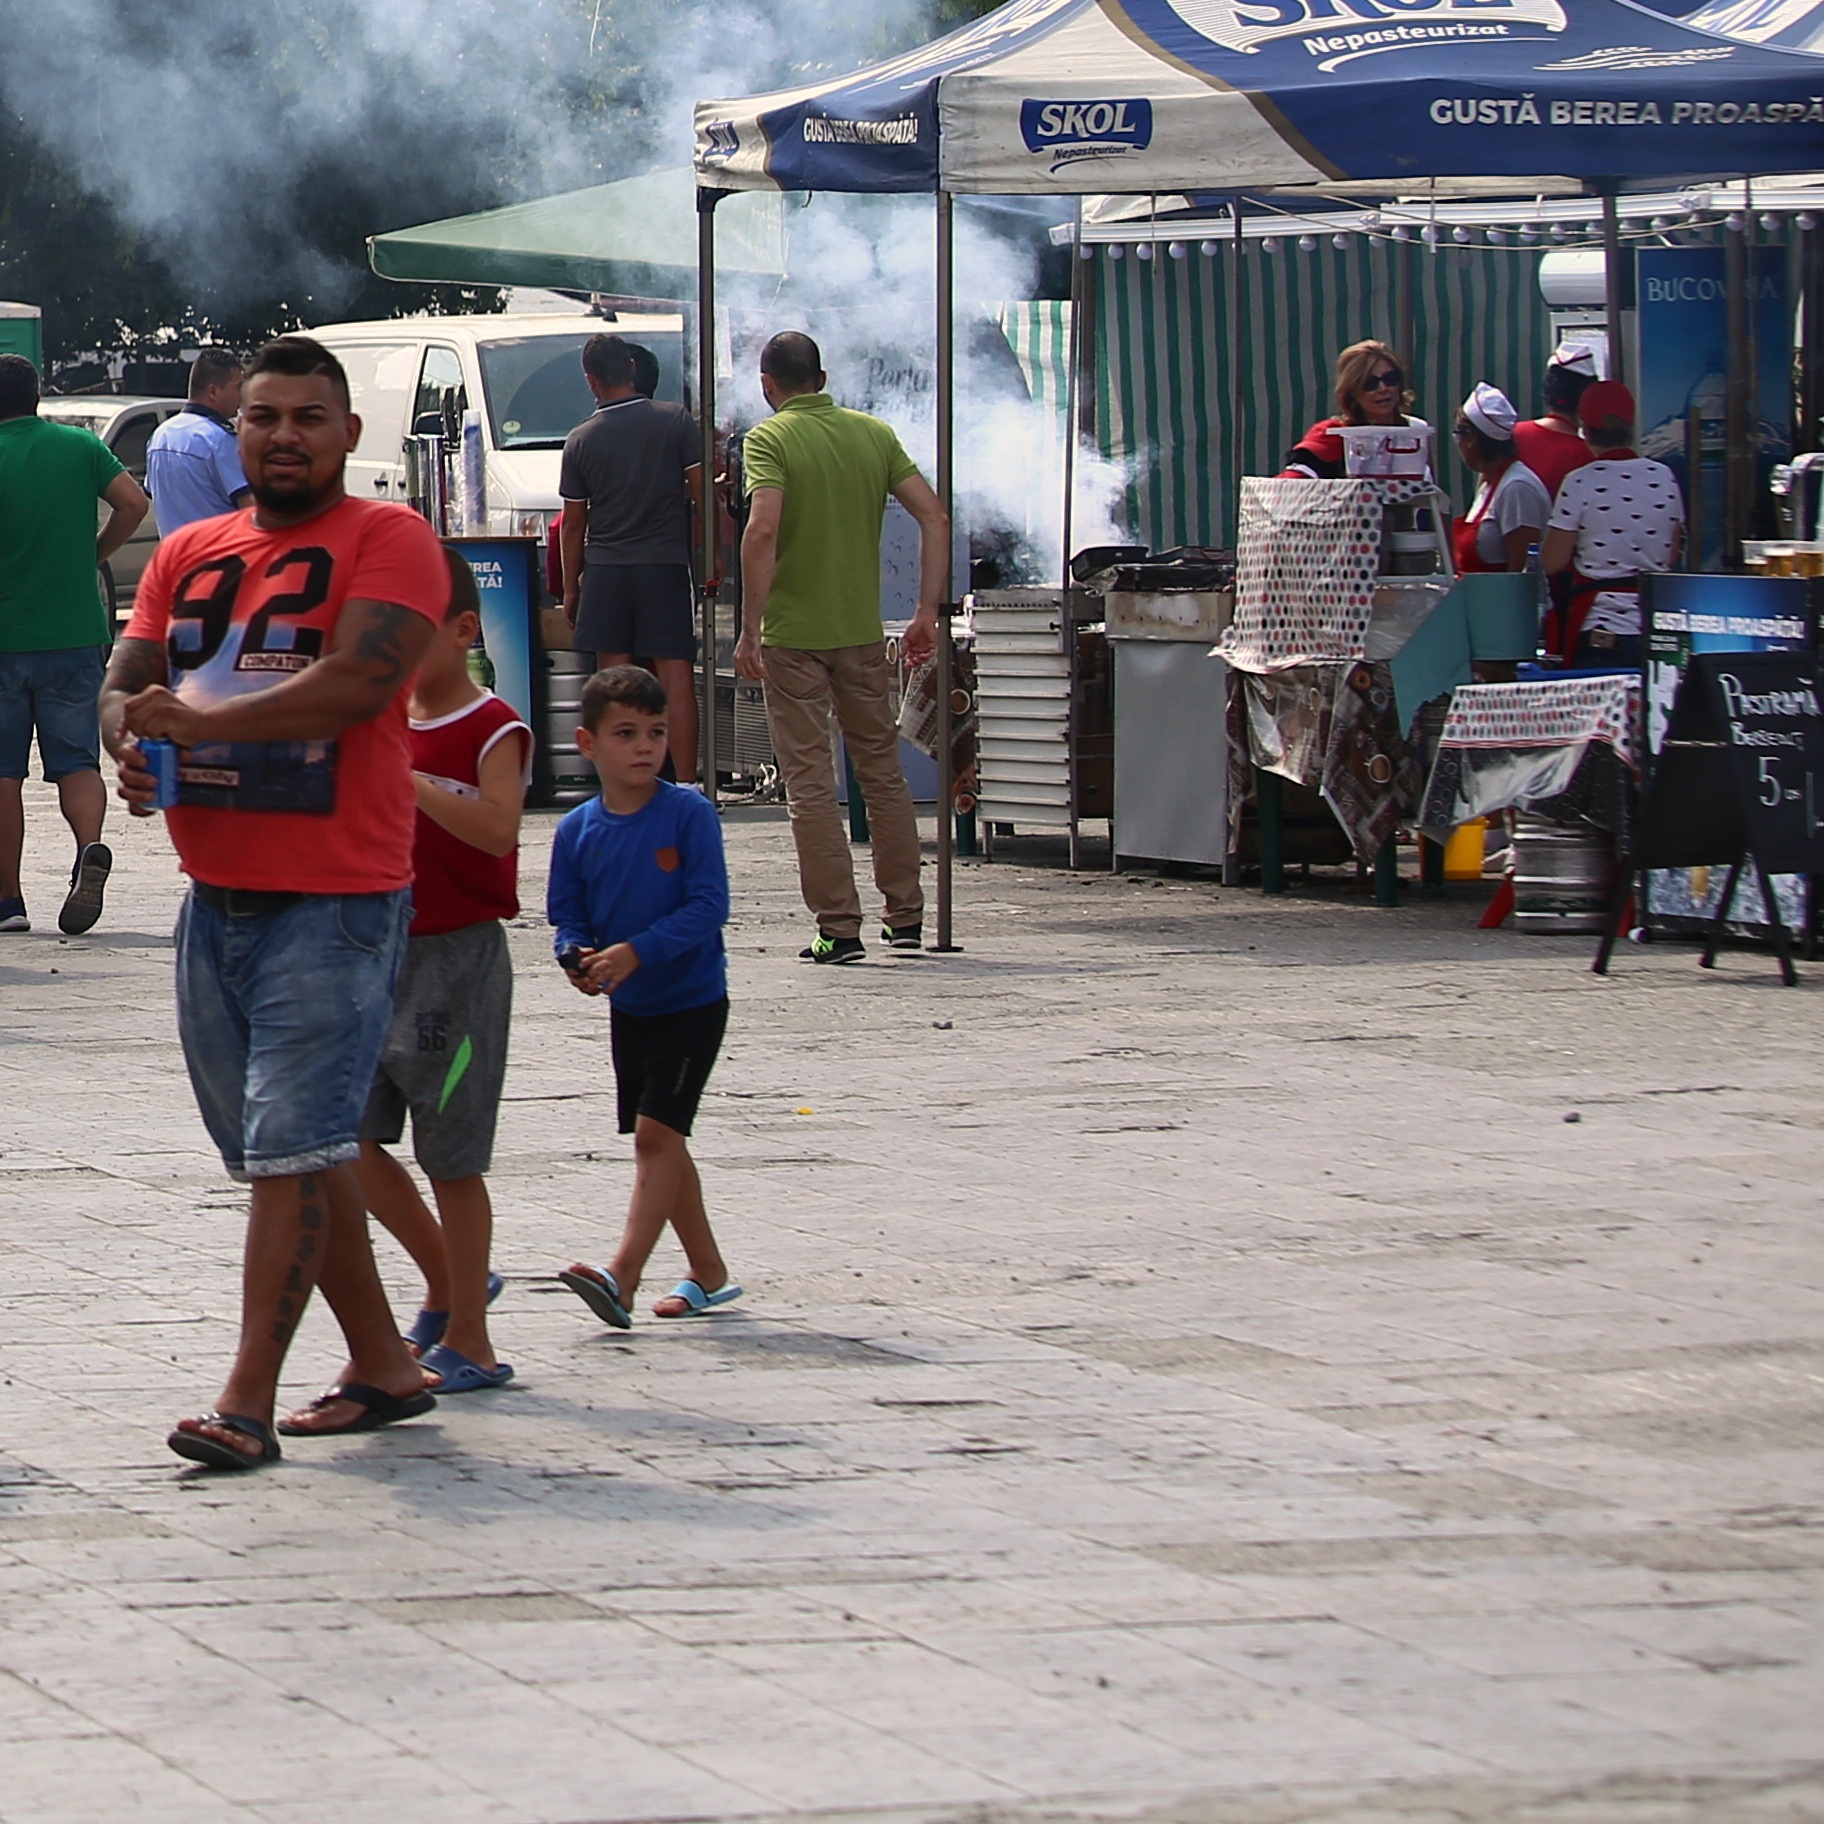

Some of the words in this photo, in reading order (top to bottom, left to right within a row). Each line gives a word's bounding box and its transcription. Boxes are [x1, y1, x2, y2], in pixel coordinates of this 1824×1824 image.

[1303, 23, 1510, 56] Nepasteurizat
[1037, 103, 1137, 138] SKOL
[1430, 93, 1541, 126] GUSTĂ
[1550, 101, 1662, 125] BEREA
[168, 545, 335, 672] 92
[1758, 755, 1782, 807] 5
